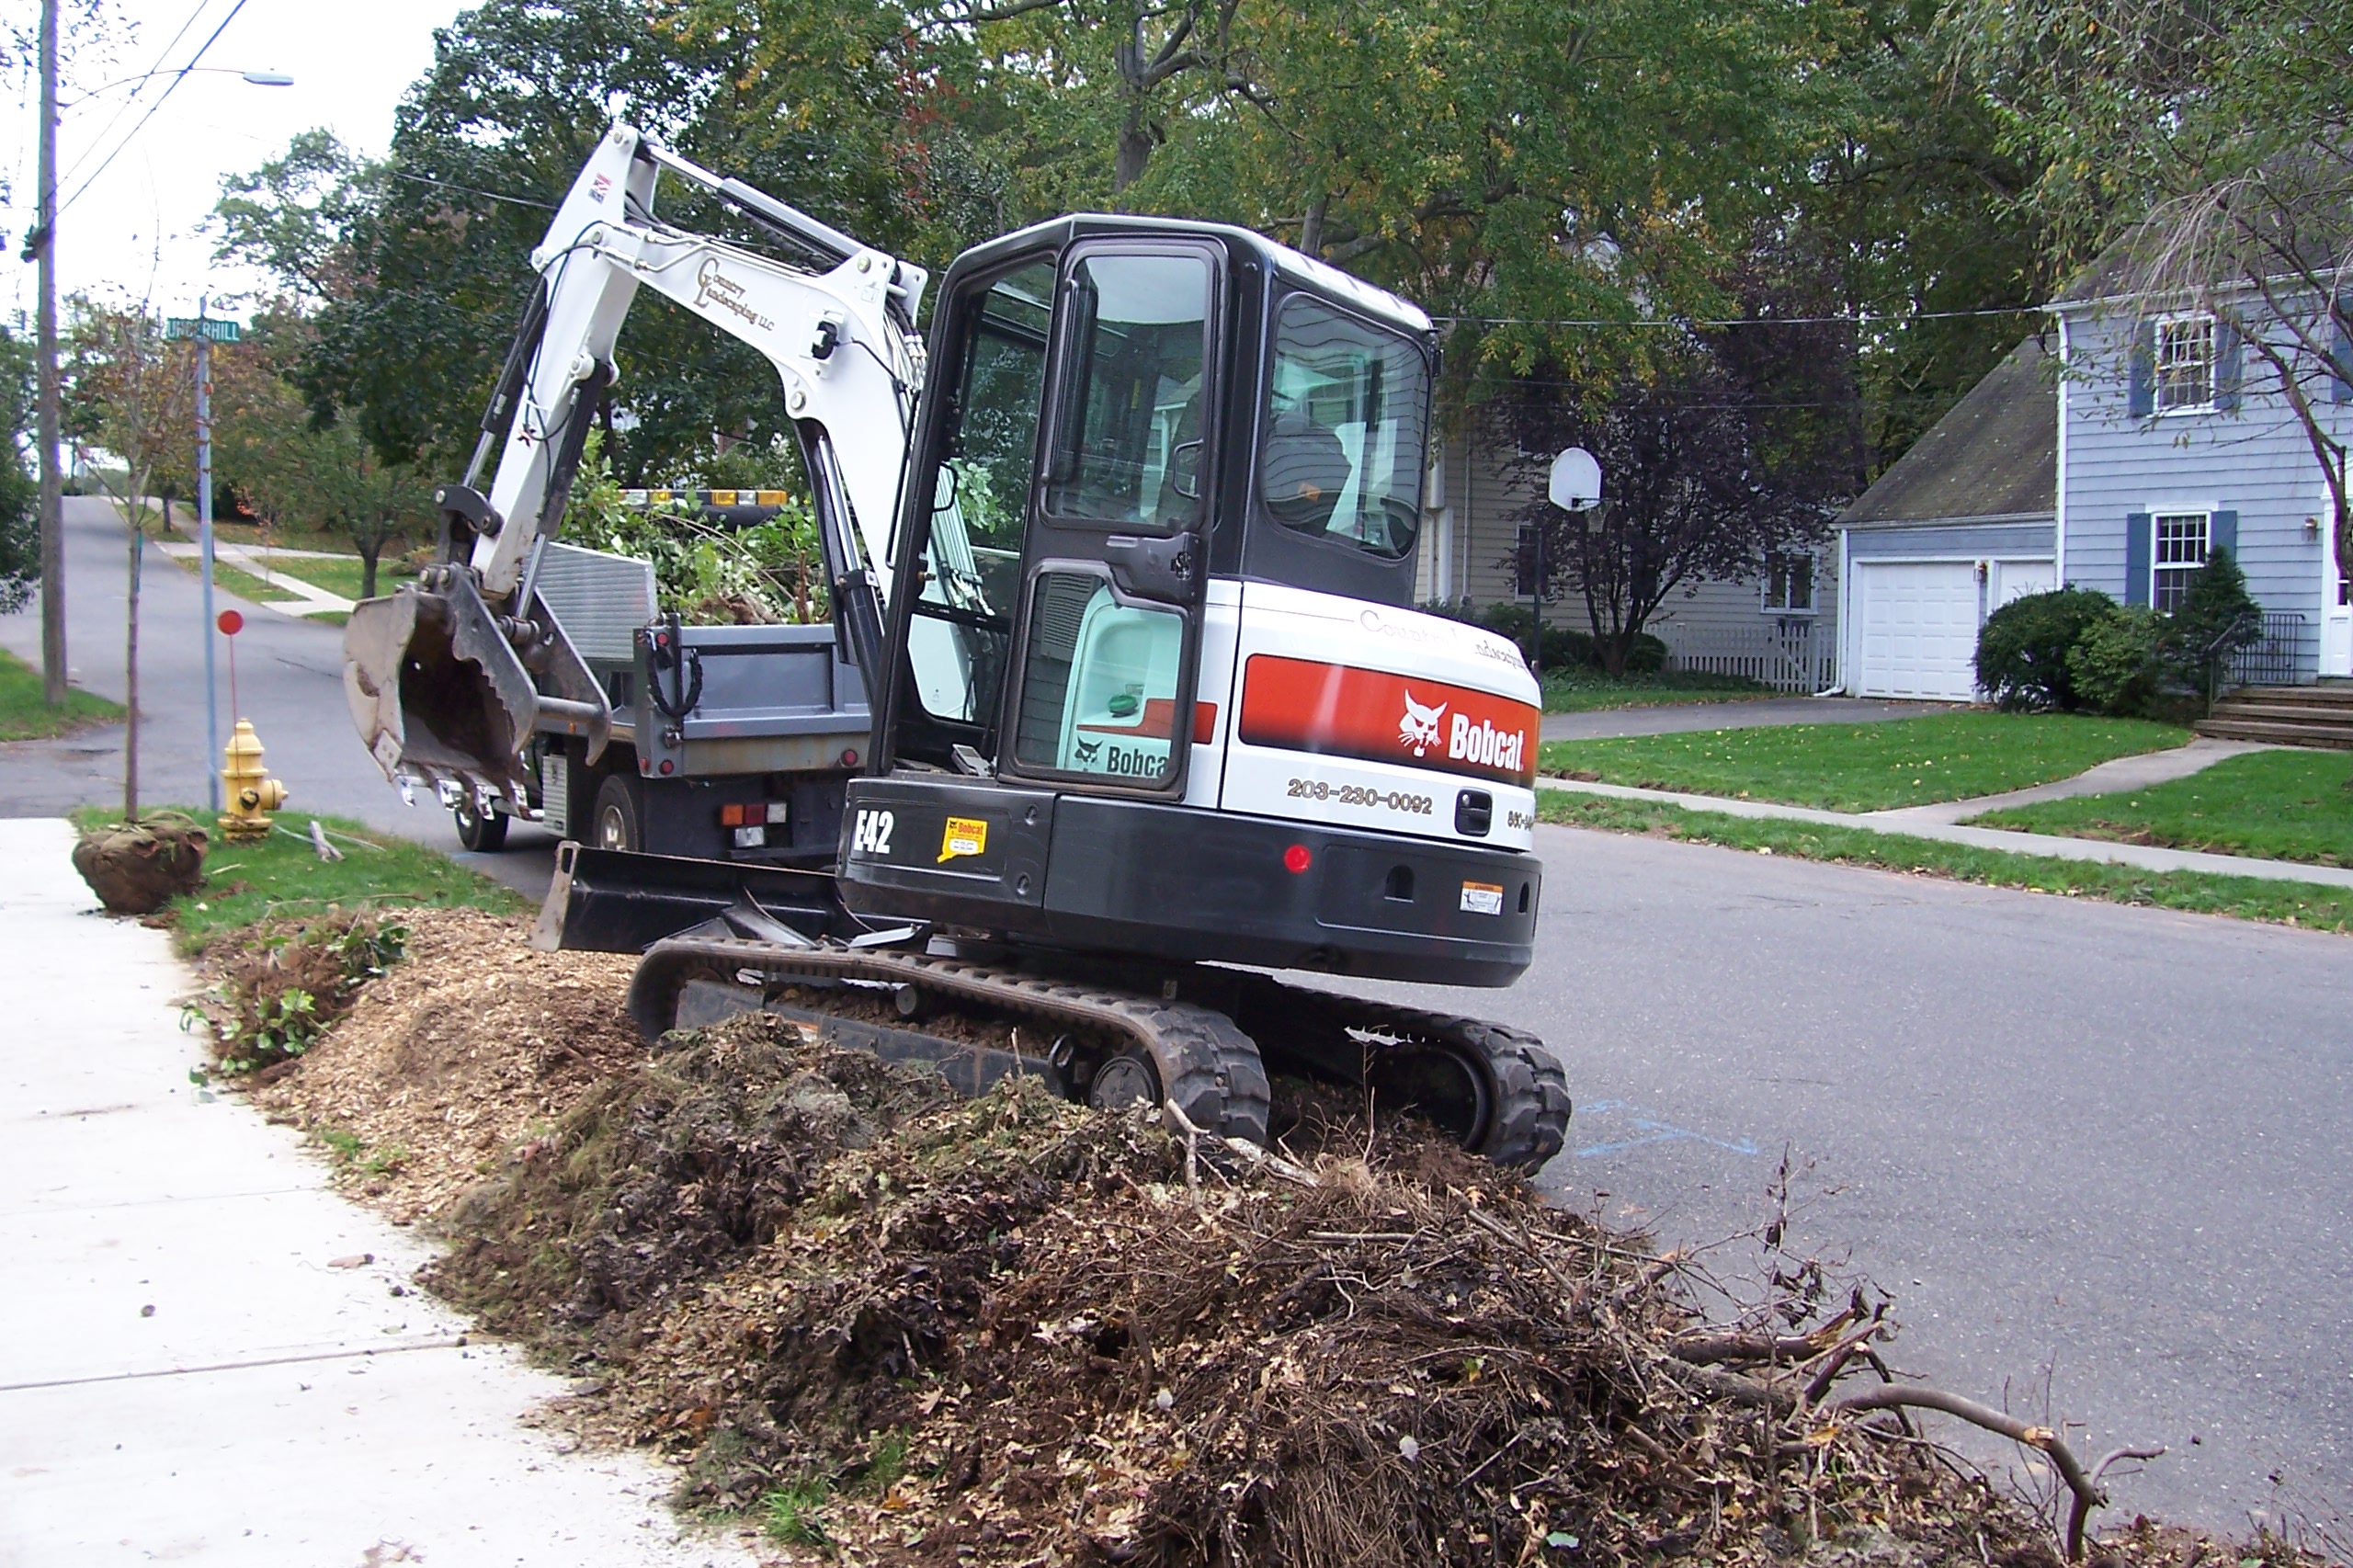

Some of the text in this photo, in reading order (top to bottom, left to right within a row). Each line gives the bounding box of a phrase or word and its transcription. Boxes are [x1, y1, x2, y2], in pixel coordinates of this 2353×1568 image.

[698, 257, 745, 299] Country
[693, 274, 775, 331] Landscaping LLC
[1107, 745, 1169, 777] Bobca
[1449, 712, 1524, 772] Bobcat
[1288, 778, 1433, 815] 203-230-0092
[854, 810, 893, 854] E42
